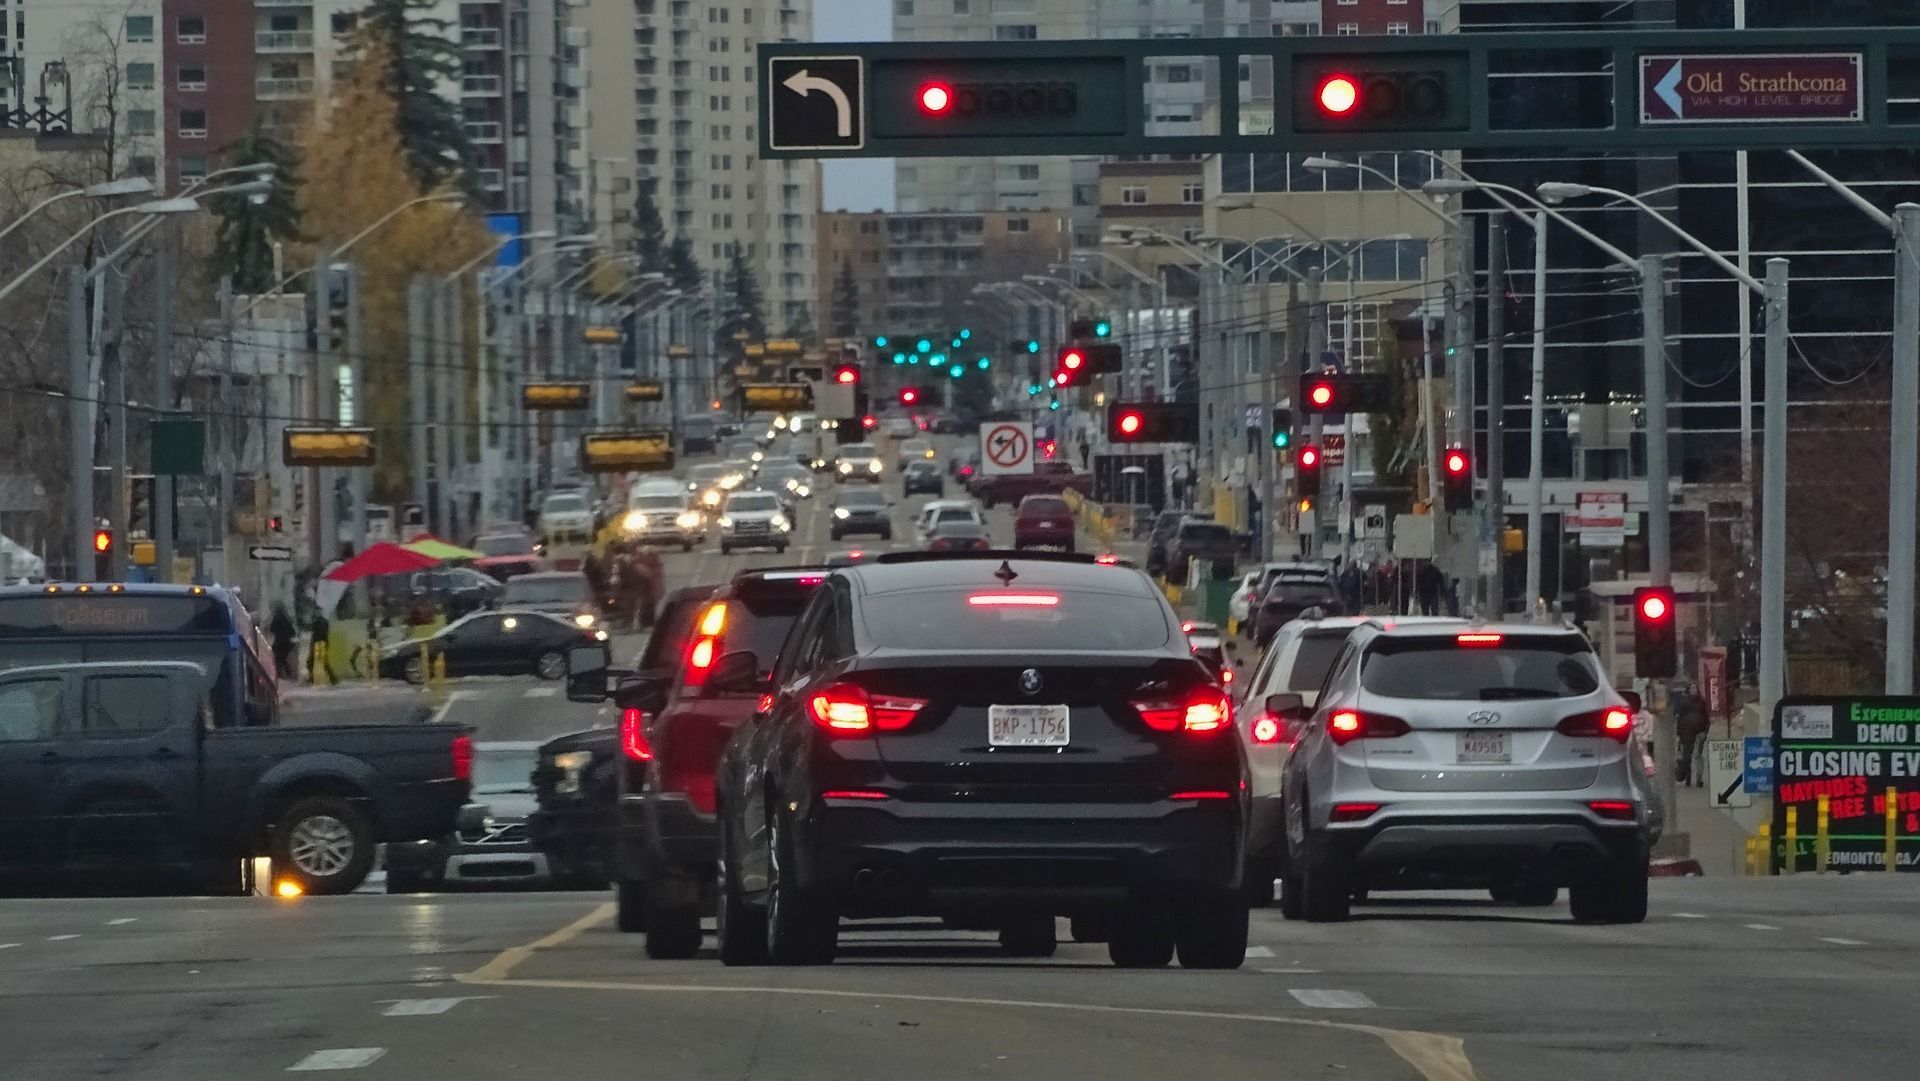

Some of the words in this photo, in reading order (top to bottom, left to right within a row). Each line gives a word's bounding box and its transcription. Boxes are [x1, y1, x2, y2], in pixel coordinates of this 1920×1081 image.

[1687, 72, 1723, 92] Old
[1739, 72, 1847, 92] Strathcona
[1691, 96, 1711, 106] VIA
[1718, 96, 1747, 106] HIGH
[1755, 95, 1792, 106] LEVEL
[1801, 94, 1844, 105] BRIDGE
[1857, 724, 1907, 743] DEMO
[1780, 751, 1881, 776] CLOSING
[1780, 777, 1867, 803] HAYRIDES
[1830, 797, 1866, 819] REE
